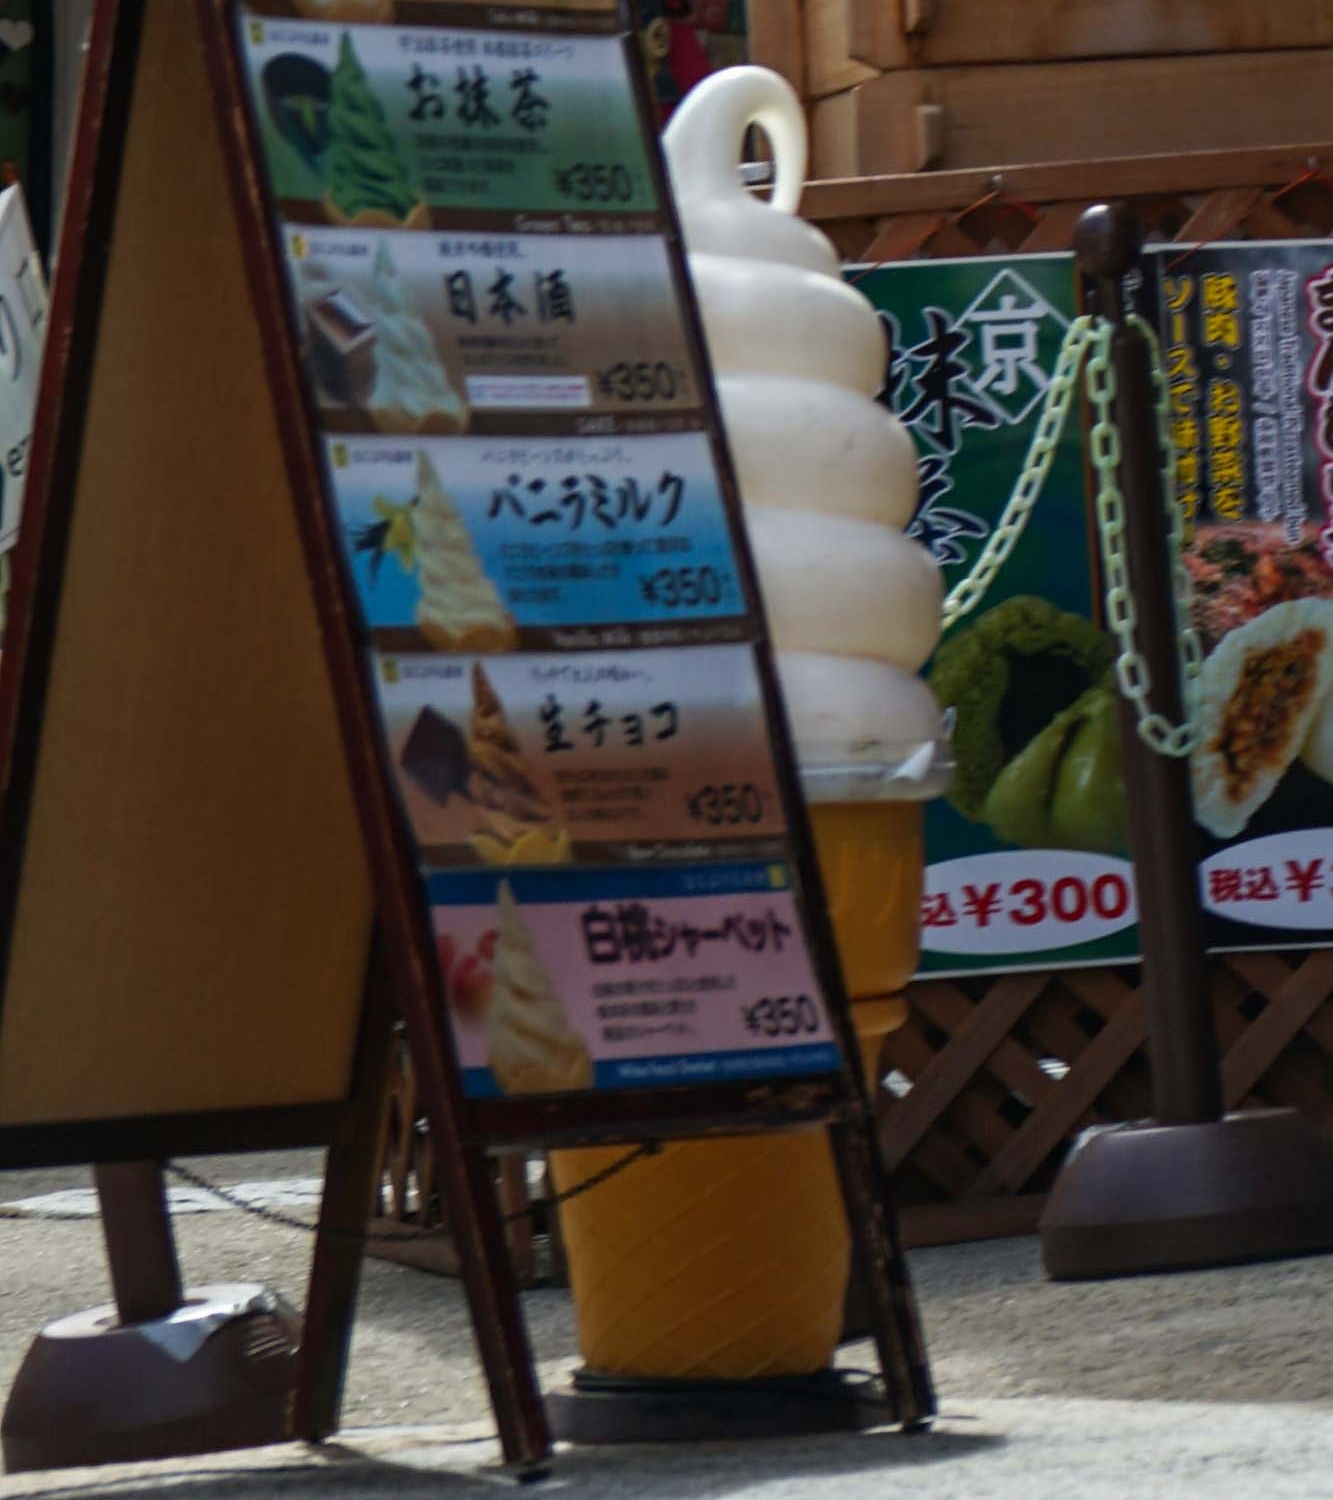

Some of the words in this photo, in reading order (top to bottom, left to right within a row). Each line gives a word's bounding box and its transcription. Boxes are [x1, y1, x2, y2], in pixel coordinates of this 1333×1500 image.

[405, 62, 550, 132] お抹茶
[554, 163, 632, 203] ¥350
[447, 268, 577, 325] 日本酒
[970, 295, 1049, 396] 京
[598, 362, 676, 401] ¥350
[487, 471, 685, 531] バニラミルク
[640, 566, 721, 607] ¥350
[538, 693, 678, 754] 生チョコ
[686, 782, 762, 824] ¥350
[581, 903, 792, 965] 白桃シャーベット
[743, 994, 819, 1037] ¥350
